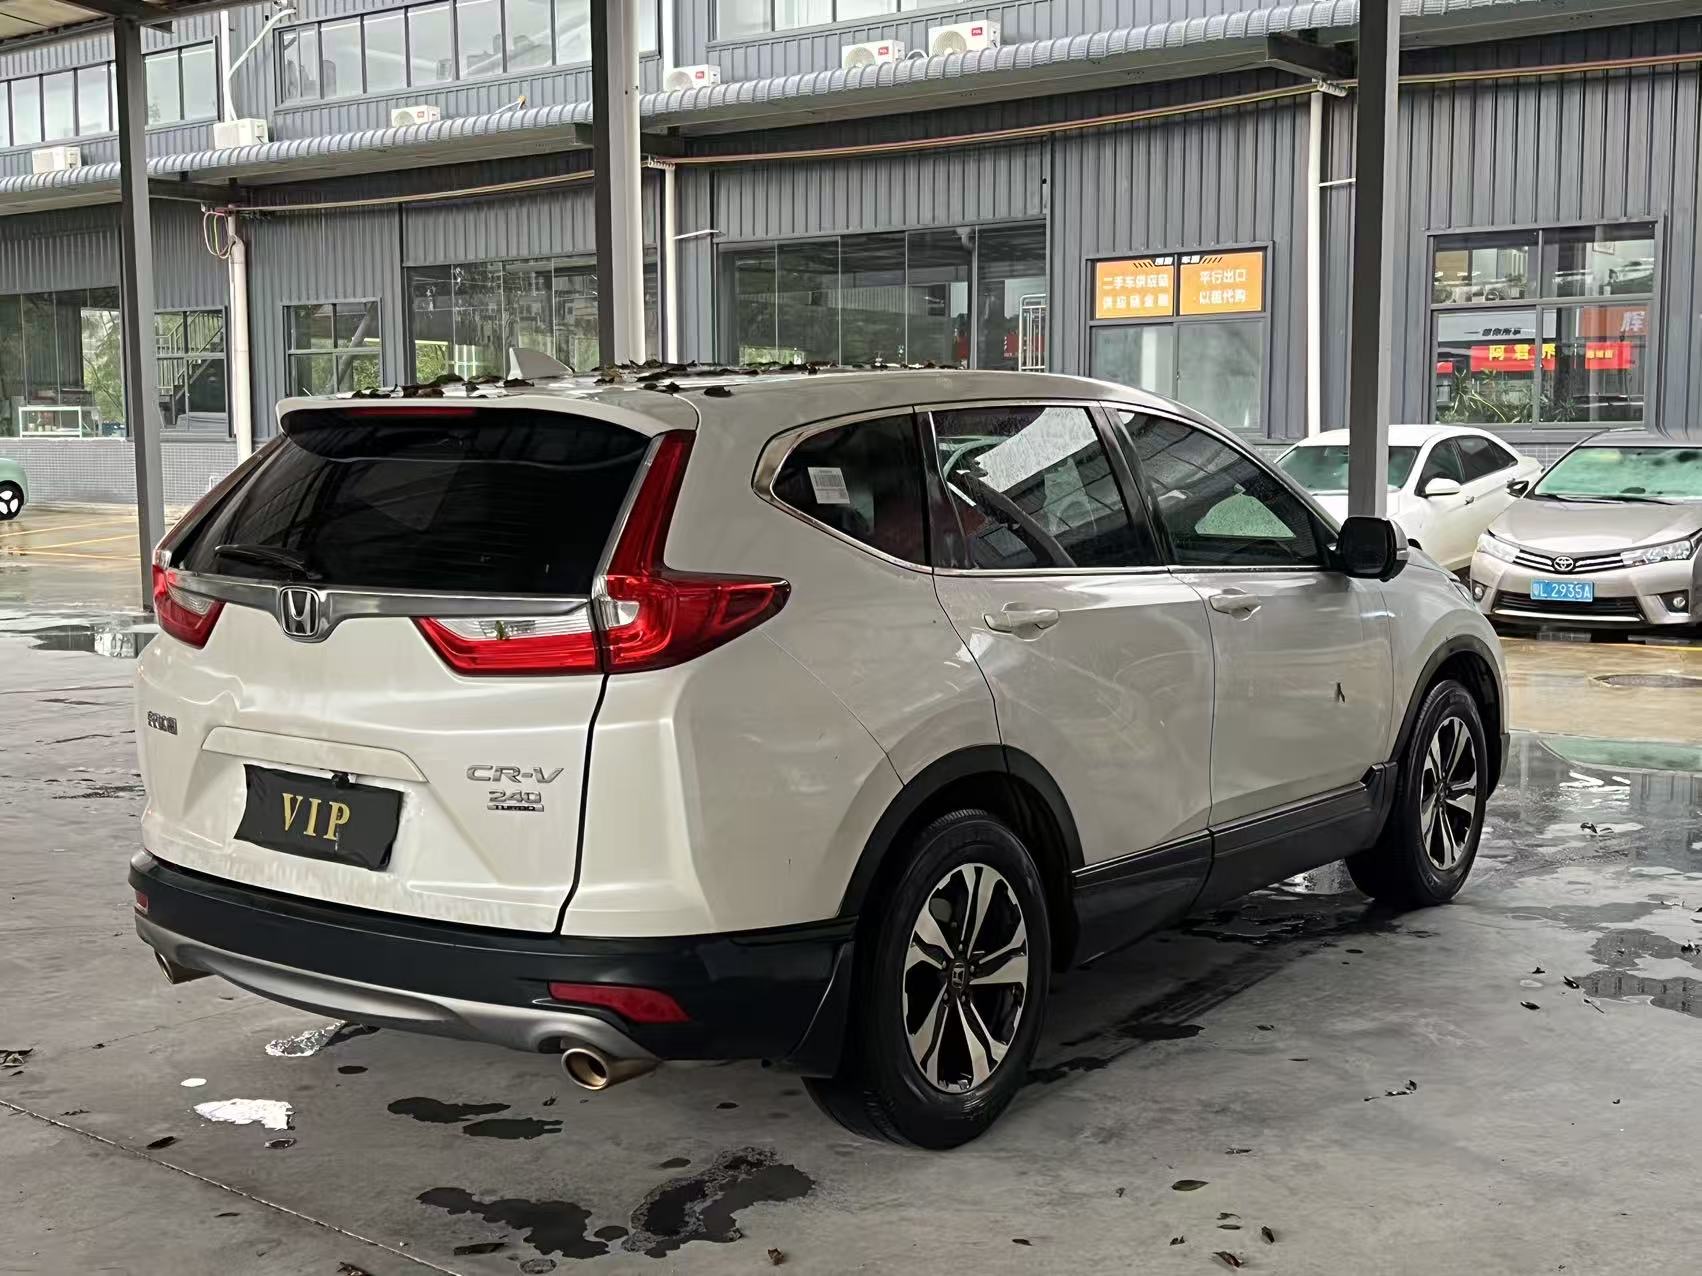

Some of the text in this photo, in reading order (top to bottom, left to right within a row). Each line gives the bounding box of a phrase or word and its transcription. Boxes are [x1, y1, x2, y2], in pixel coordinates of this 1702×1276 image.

[1199, 269, 1247, 285] 平行出口
[466, 765, 565, 784] CR-V
[488, 789, 542, 803] 240
[281, 793, 351, 841] VIP
